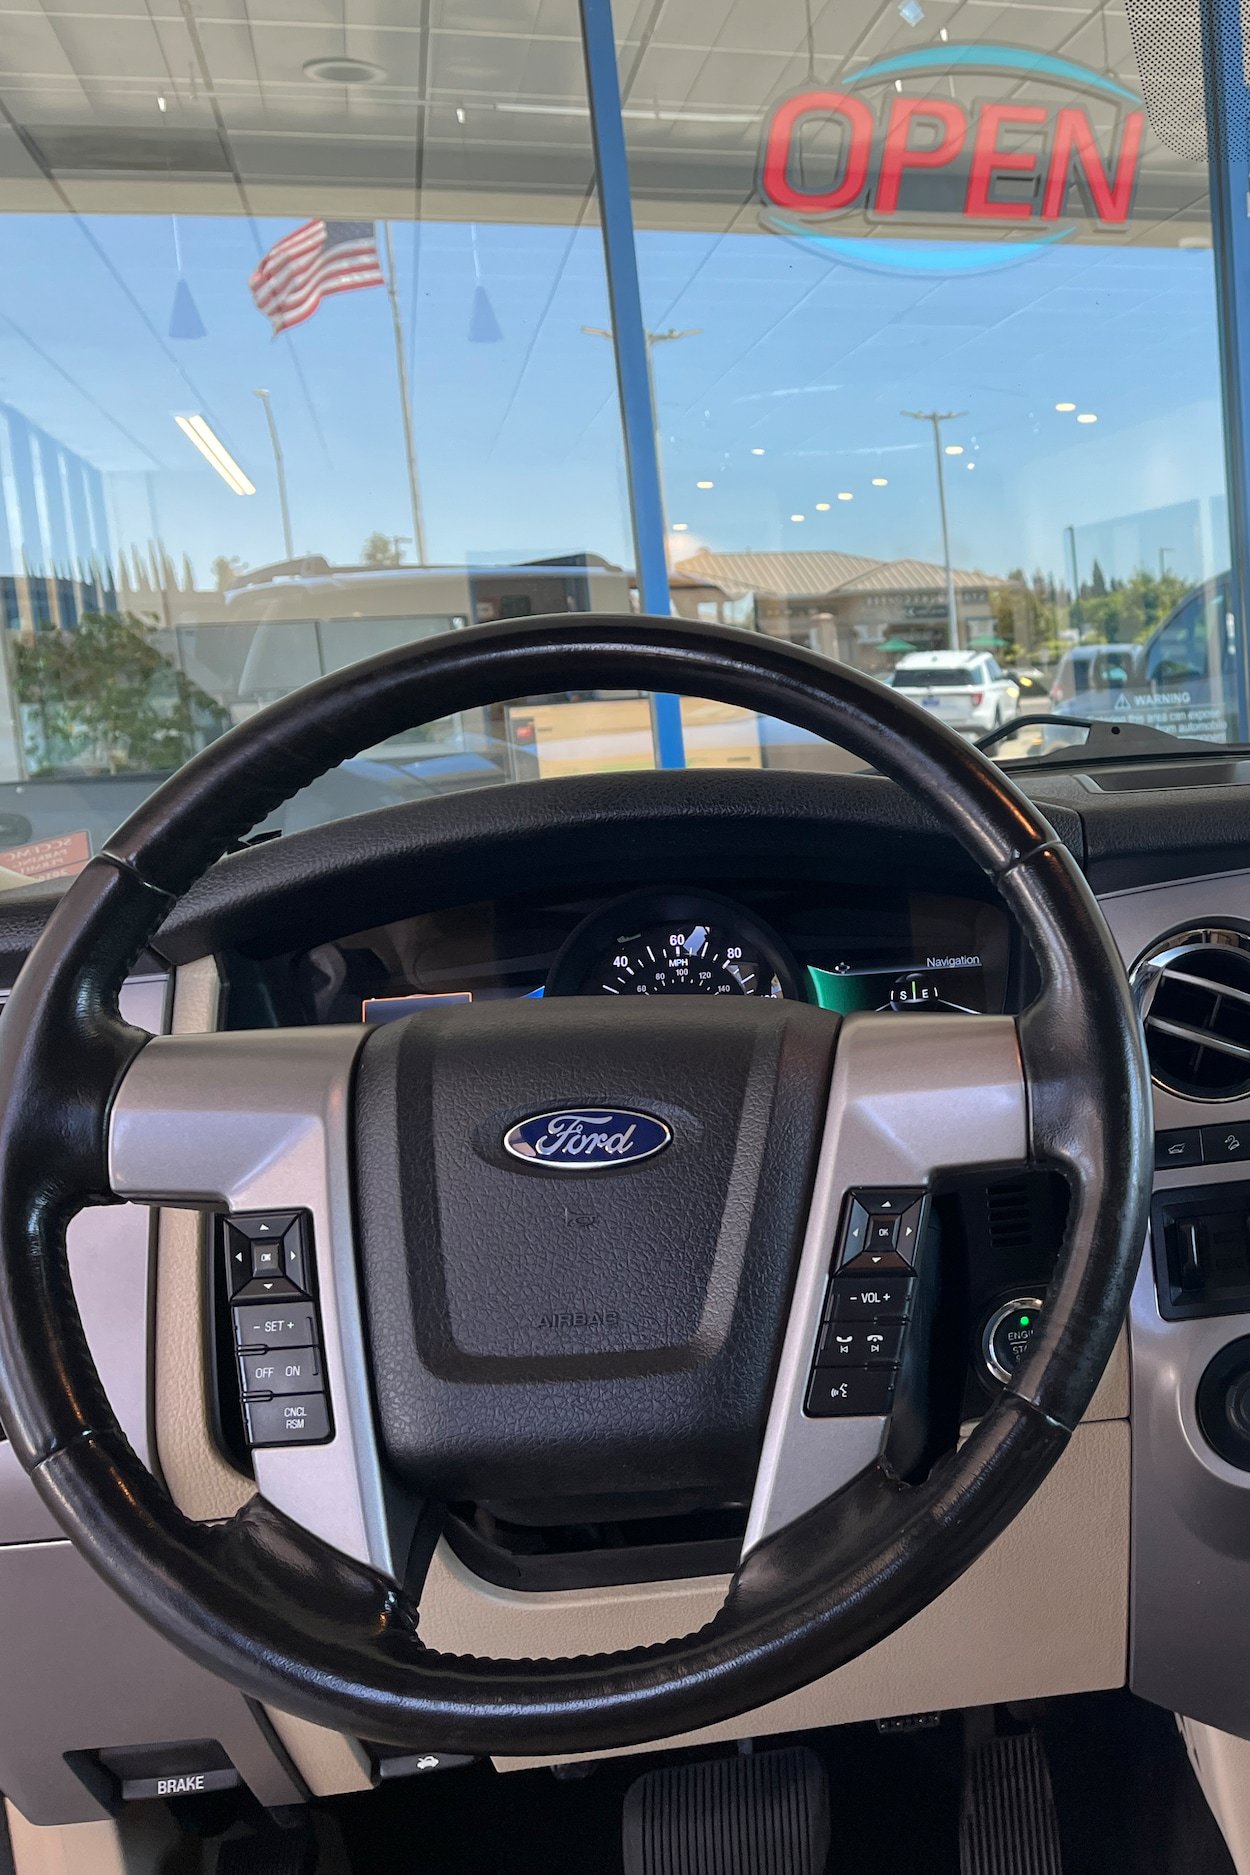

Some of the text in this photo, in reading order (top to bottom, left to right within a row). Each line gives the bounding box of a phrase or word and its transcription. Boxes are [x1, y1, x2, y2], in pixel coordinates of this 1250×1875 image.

[763, 91, 1145, 224] OPEN
[1134, 692, 1191, 706] WARNING
[1147, 713, 1168, 723] area
[1169, 711, 1187, 721] can
[669, 934, 685, 947] 60
[727, 947, 742, 959] 80
[613, 956, 629, 968] 40
[668, 958, 689, 967] MPH
[926, 954, 980, 968] Navigation
[655, 972, 666, 981] 80
[675, 968, 689, 976] 100
[698, 971, 712, 980] 120
[636, 984, 647, 993] 60
[717, 984, 731, 993] 140
[535, 1115, 637, 1156] Ford
[879, 1228, 889, 1237] OK
[260, 1253, 272, 1262] OK
[537, 1311, 619, 1329] AIRBAG
[255, 1365, 301, 1379] OFF ON
[284, 1407, 307, 1418] CNCL
[286, 1418, 304, 1429] RSM
[157, 1775, 205, 1795] BRAKE
